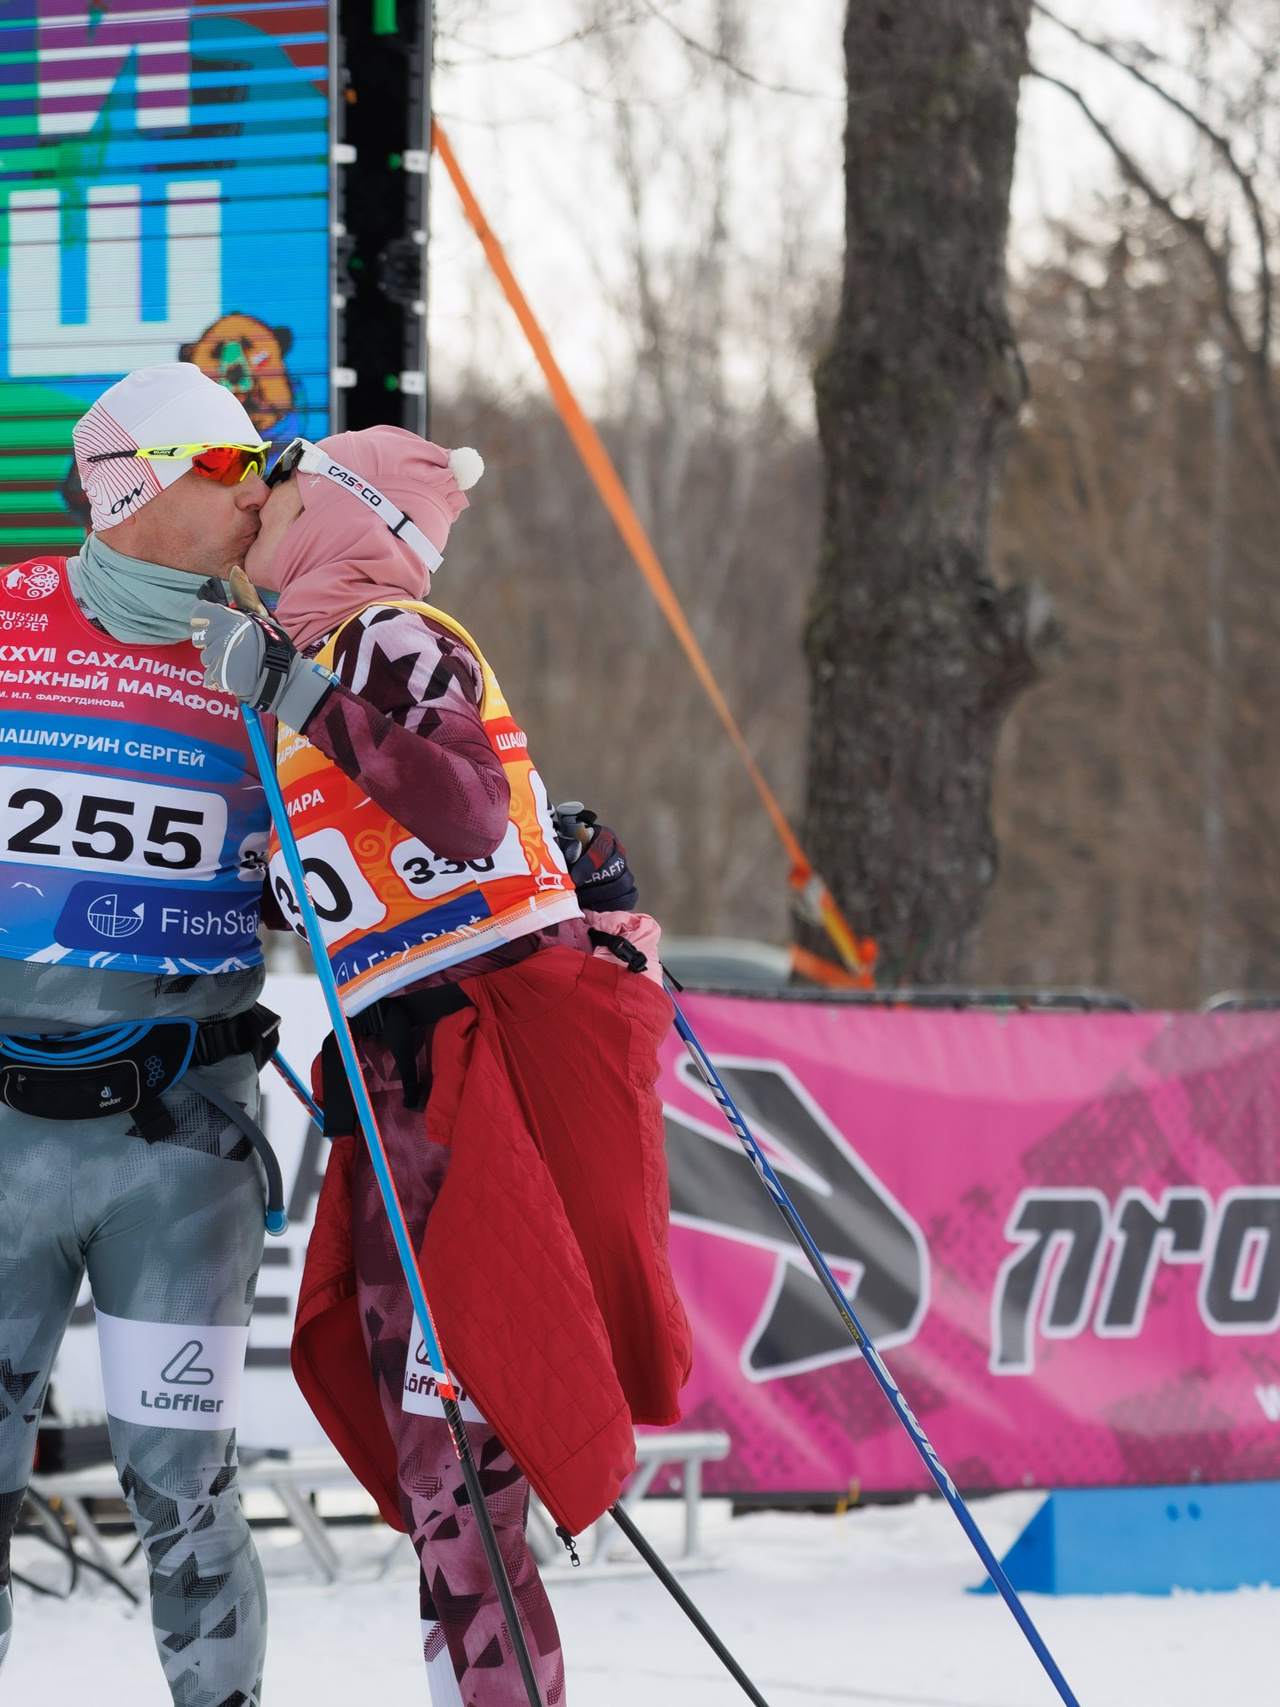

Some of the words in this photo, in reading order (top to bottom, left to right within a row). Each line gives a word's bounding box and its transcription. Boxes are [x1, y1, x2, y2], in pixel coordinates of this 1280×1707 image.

[328, 465, 382, 507] CASCO
[67, 649, 234, 694] САХАЛИНС
[35, 693, 125, 709] ФАРХУТДИНОВА
[117, 677, 240, 721] МАРАФОН
[124, 741, 206, 768] СЕРГЕЙ
[7, 788, 205, 870] 255
[161, 907, 259, 936] FishStat
[140, 1390, 224, 1413] Löffler
